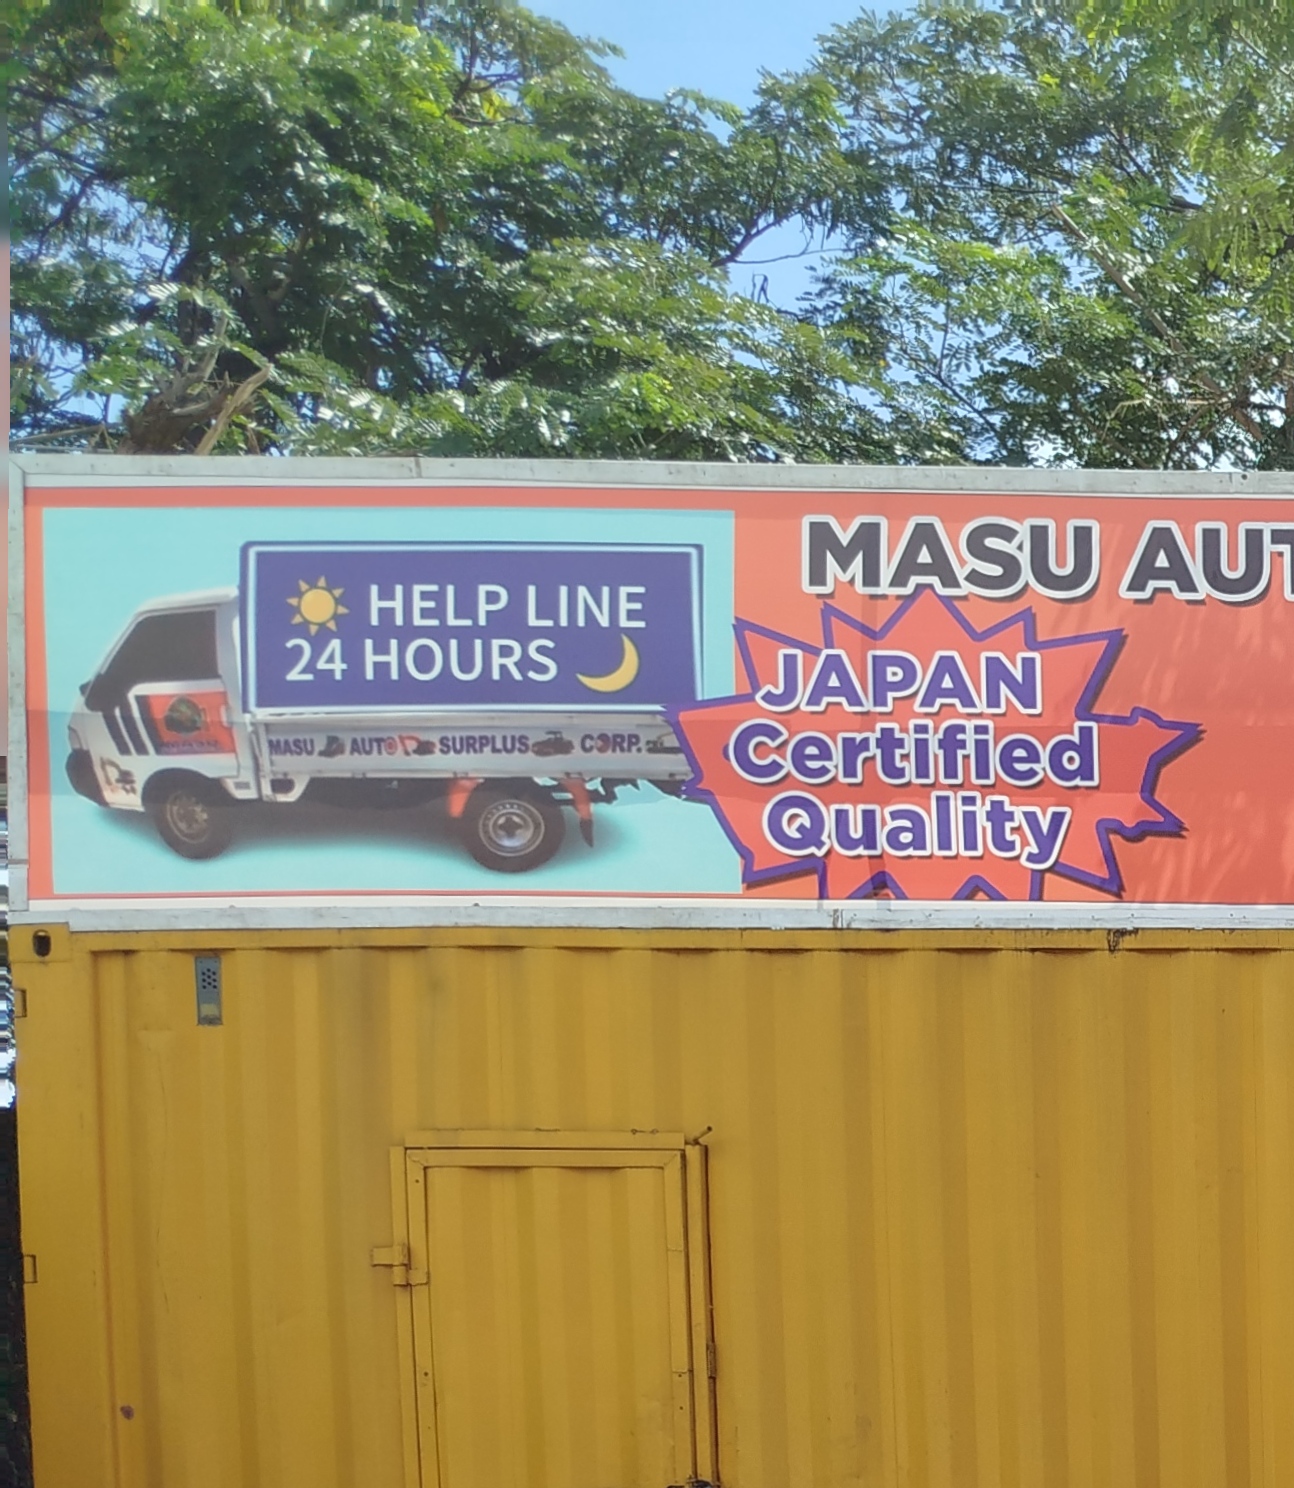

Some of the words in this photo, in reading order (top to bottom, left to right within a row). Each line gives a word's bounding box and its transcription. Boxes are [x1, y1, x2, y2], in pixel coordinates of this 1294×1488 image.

[806, 519, 1097, 595] MASU
[370, 584, 508, 627] HELP
[528, 585, 646, 628] LINE
[285, 638, 346, 681] 24
[365, 638, 558, 682] HOURS
[758, 651, 1040, 713] JAPAN
[268, 739, 315, 755] MASU
[349, 738, 398, 756] AUTO
[439, 735, 530, 754] SURPLUS
[732, 722, 1097, 783] Certified
[766, 794, 1068, 867] Quality
